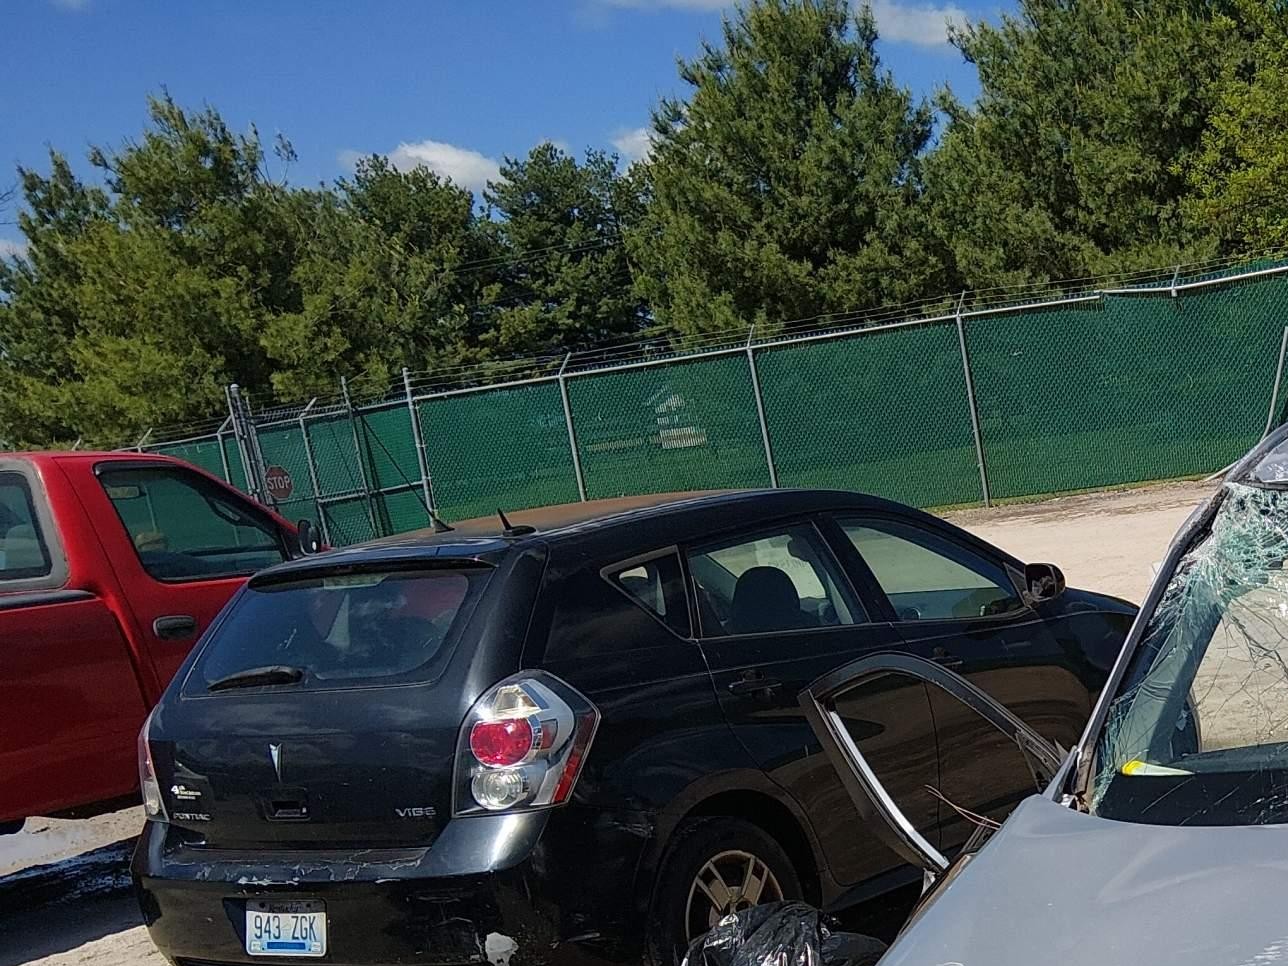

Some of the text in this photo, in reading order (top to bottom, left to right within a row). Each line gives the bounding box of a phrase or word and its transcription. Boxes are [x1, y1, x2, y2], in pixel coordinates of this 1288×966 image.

[267, 475, 290, 490] STOP
[254, 915, 317, 942] 943 ZGK
